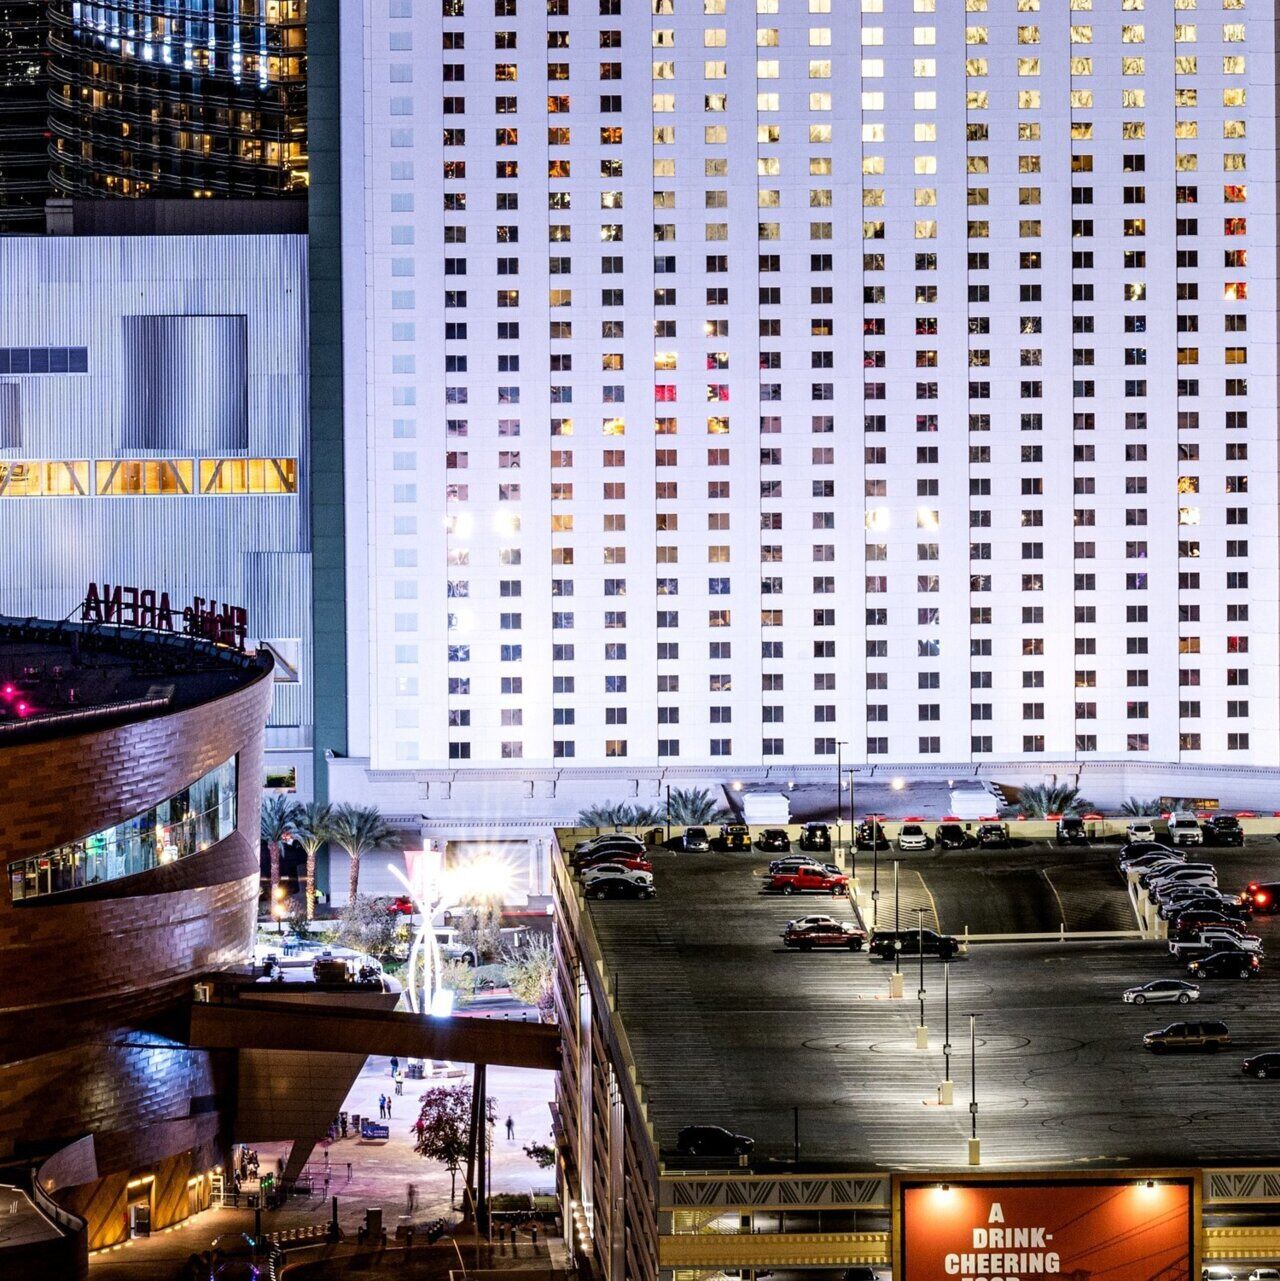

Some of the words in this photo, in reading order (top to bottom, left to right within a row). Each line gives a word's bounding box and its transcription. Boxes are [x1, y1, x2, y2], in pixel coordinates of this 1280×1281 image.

[988, 1203, 1005, 1223] A
[973, 1227, 1053, 1249] DRINK-
[944, 1252, 1060, 1275] CHEERING
